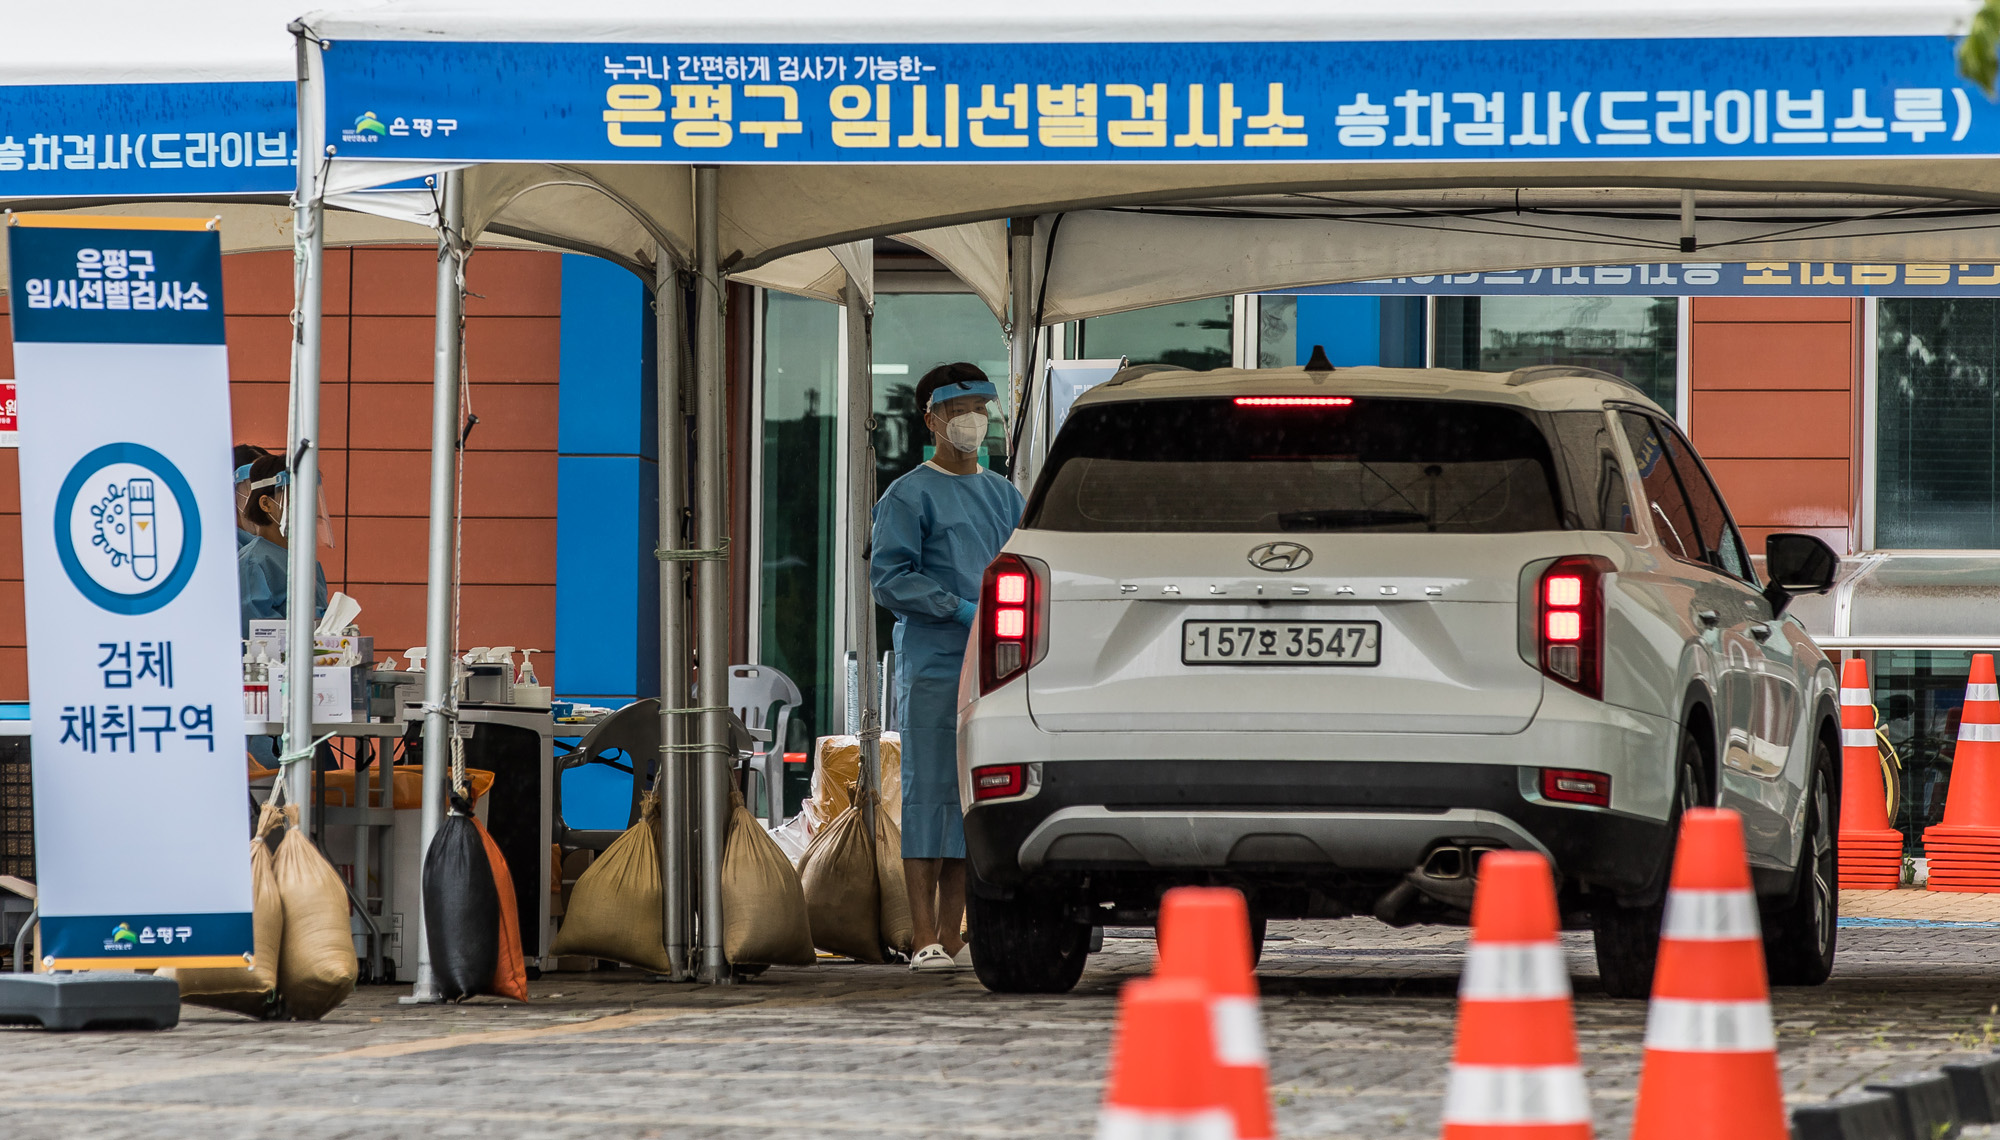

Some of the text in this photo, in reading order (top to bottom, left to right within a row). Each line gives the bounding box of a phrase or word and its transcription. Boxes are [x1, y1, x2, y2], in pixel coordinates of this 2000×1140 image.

[604, 56, 670, 80] 누구나
[678, 56, 770, 81] 간편하게
[778, 56, 847, 81] 검사가
[389, 117, 458, 138] 은평구
[603, 83, 1973, 148] 은평구 임시선별검사소 승차검사(드라이브스루)
[0, 132, 298, 171] 승차검사(드라이브
[76, 248, 156, 280] 은평구
[25, 278, 209, 310] 임시선별검사소
[1121, 584, 1443, 595] PALISADE
[1198, 626, 1367, 658] 157호 3547
[97, 641, 173, 689] 검체
[59, 704, 214, 753] 채취구역
[139, 926, 192, 945] 은평구
